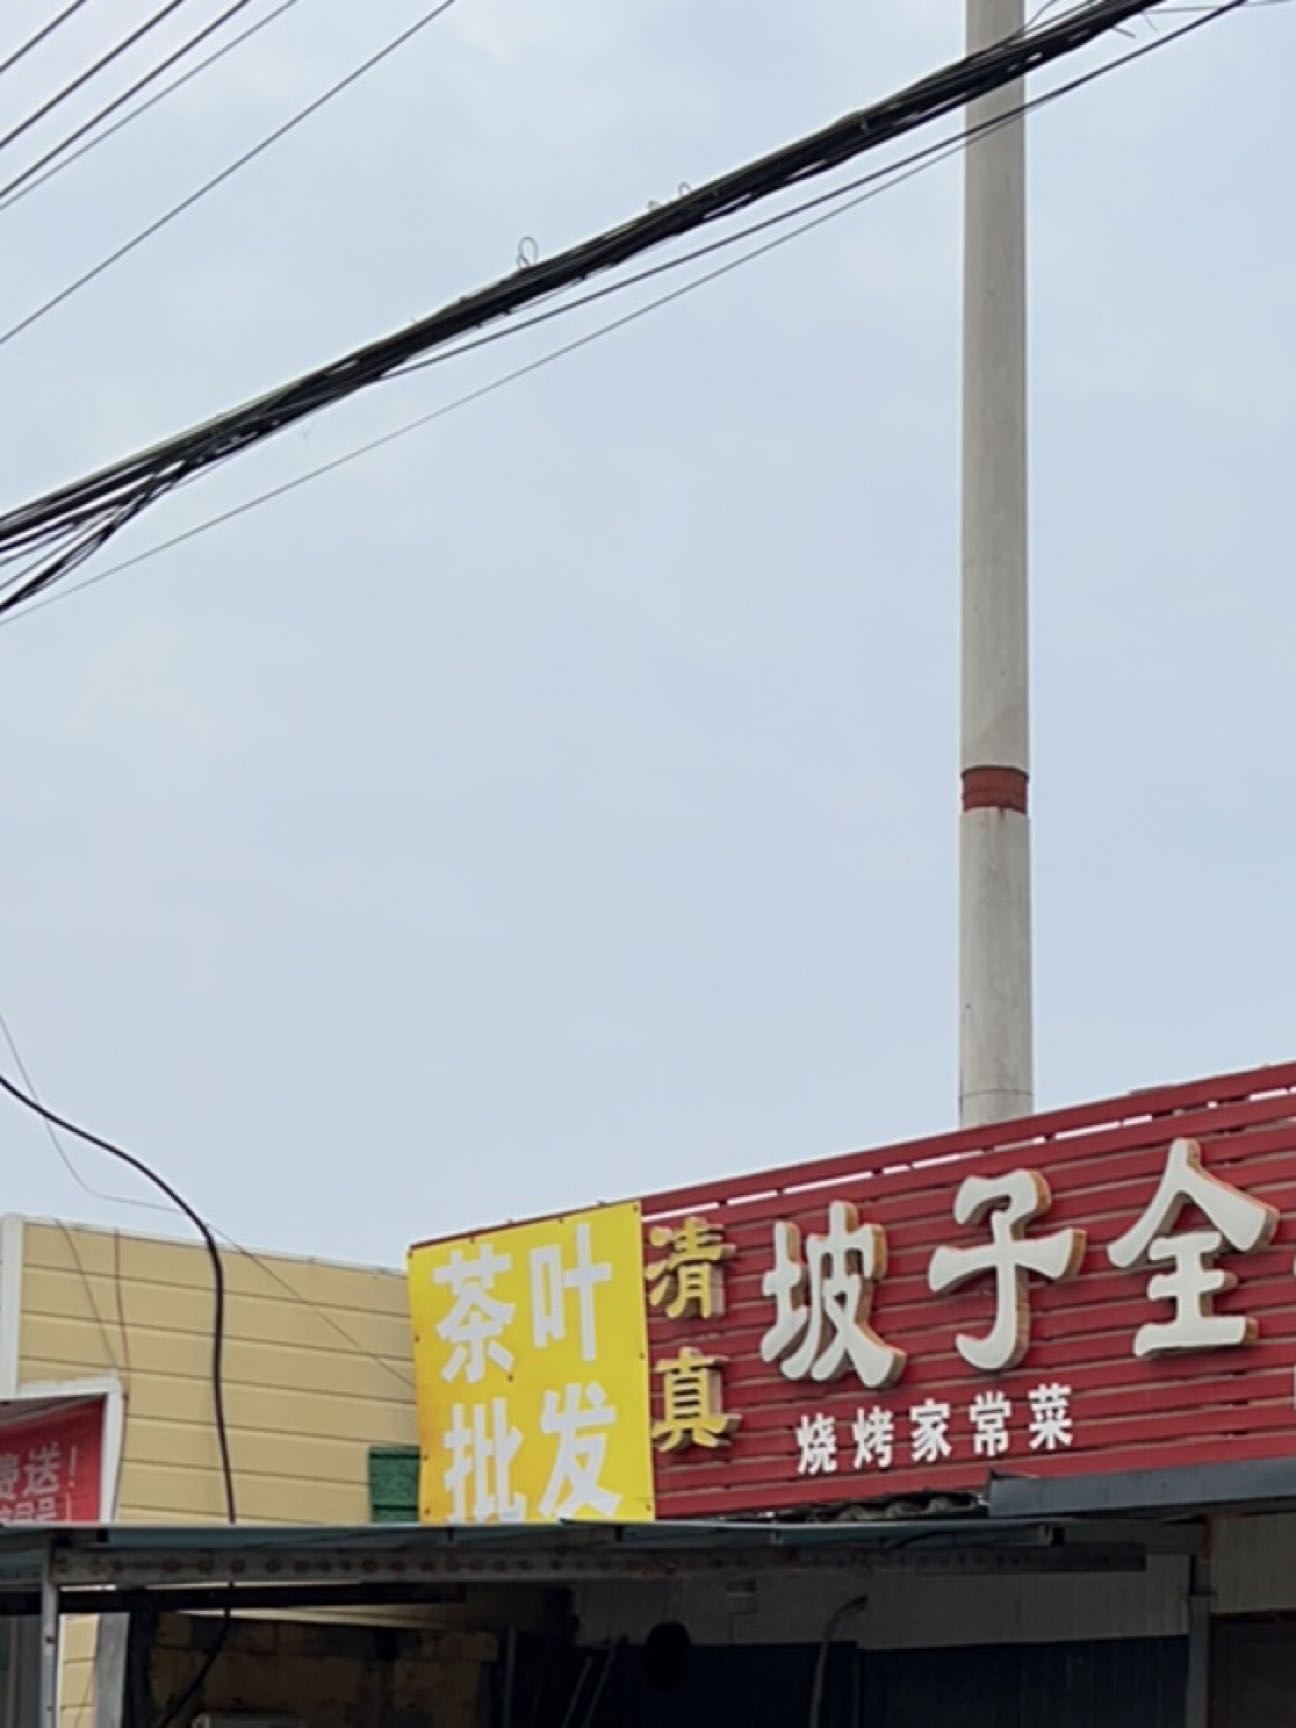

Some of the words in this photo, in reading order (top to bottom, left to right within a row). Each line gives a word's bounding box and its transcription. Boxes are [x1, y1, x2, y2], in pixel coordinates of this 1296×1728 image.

[433, 1222, 613, 1384] 茶叶
[646, 1216, 742, 1453] 清真
[440, 1383, 622, 1523] 批发
[795, 1382, 1074, 1476] 烧烤家常菜
